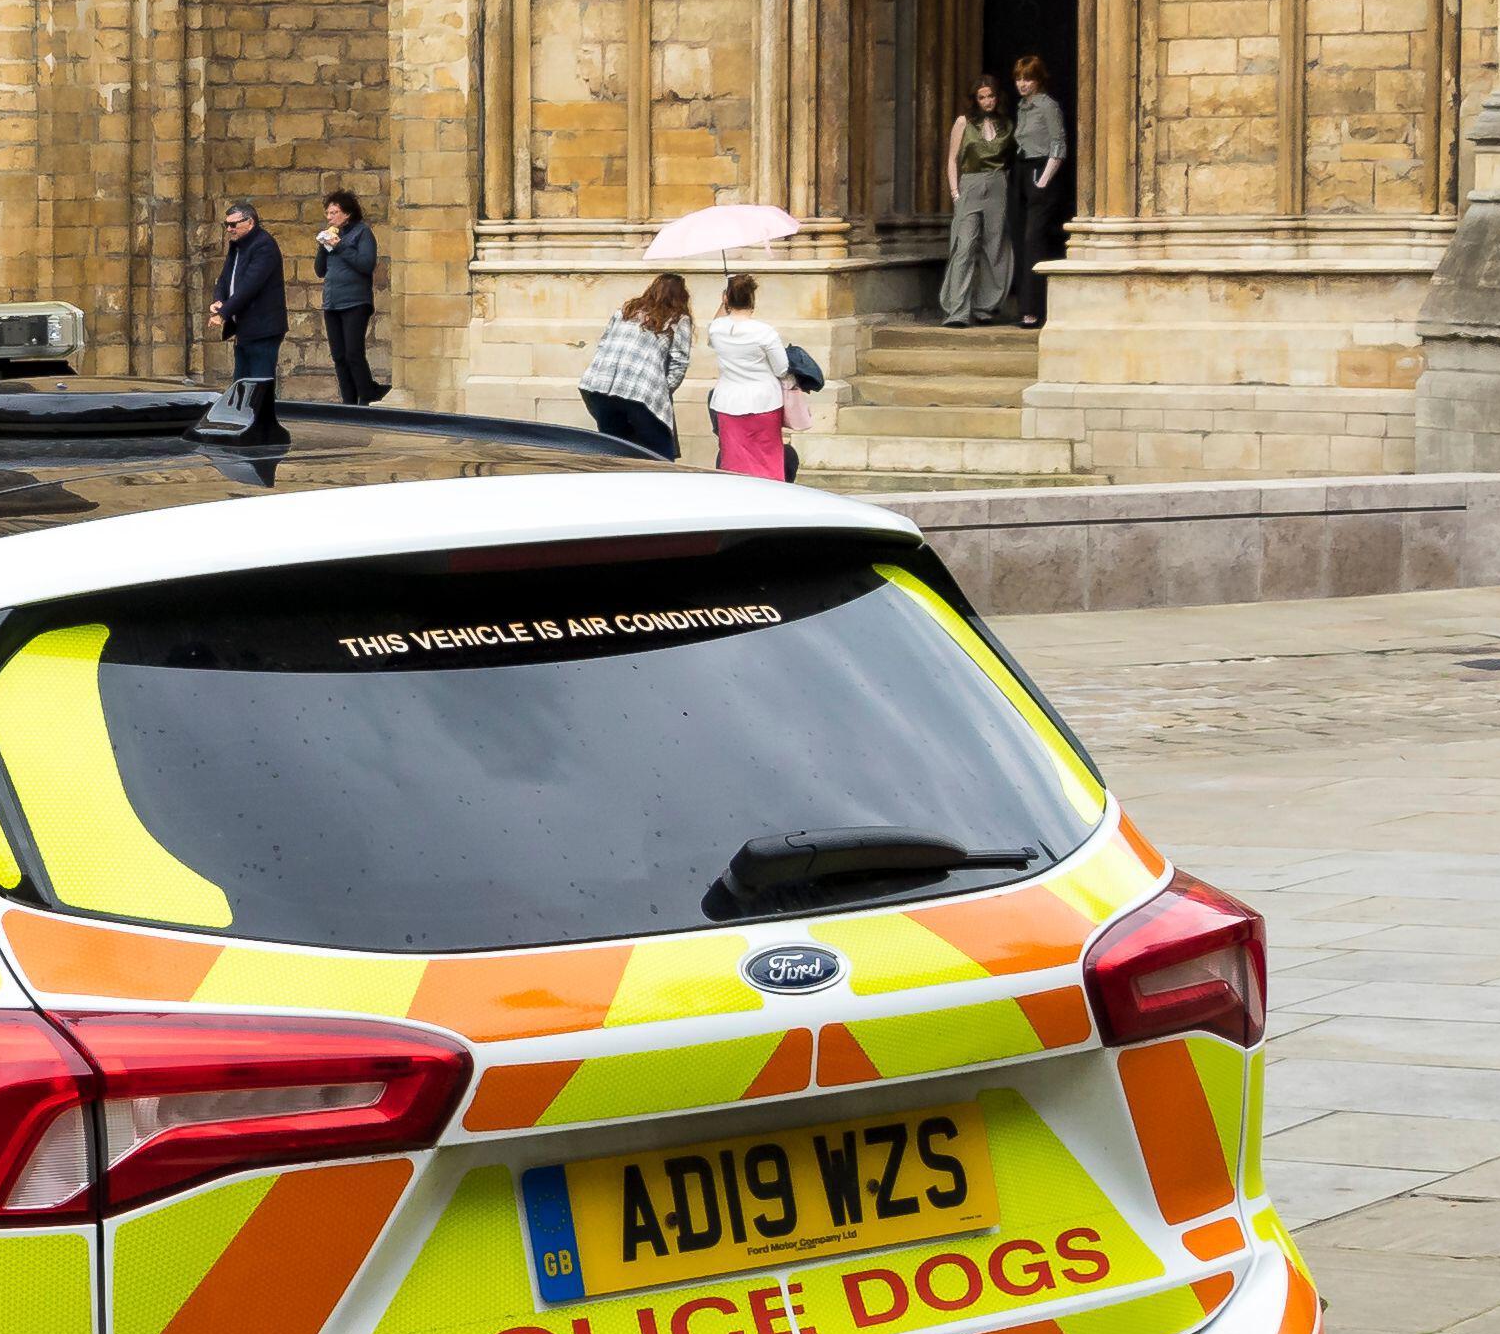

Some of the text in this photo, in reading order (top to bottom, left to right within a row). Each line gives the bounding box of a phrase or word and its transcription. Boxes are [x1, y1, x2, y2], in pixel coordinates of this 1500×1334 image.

[339, 604, 783, 657] THIS VEHICLE IS AIR CONDITIONED
[768, 954, 824, 982] Ford
[621, 1116, 969, 1263] AD19 WZS
[747, 1246, 769, 1256] Ford
[770, 1241, 798, 1252] Motor
[799, 1233, 842, 1247] Company
[842, 1229, 858, 1240] Ltd
[543, 1249, 574, 1278] GB
[841, 1227, 1112, 1330] DOGS
